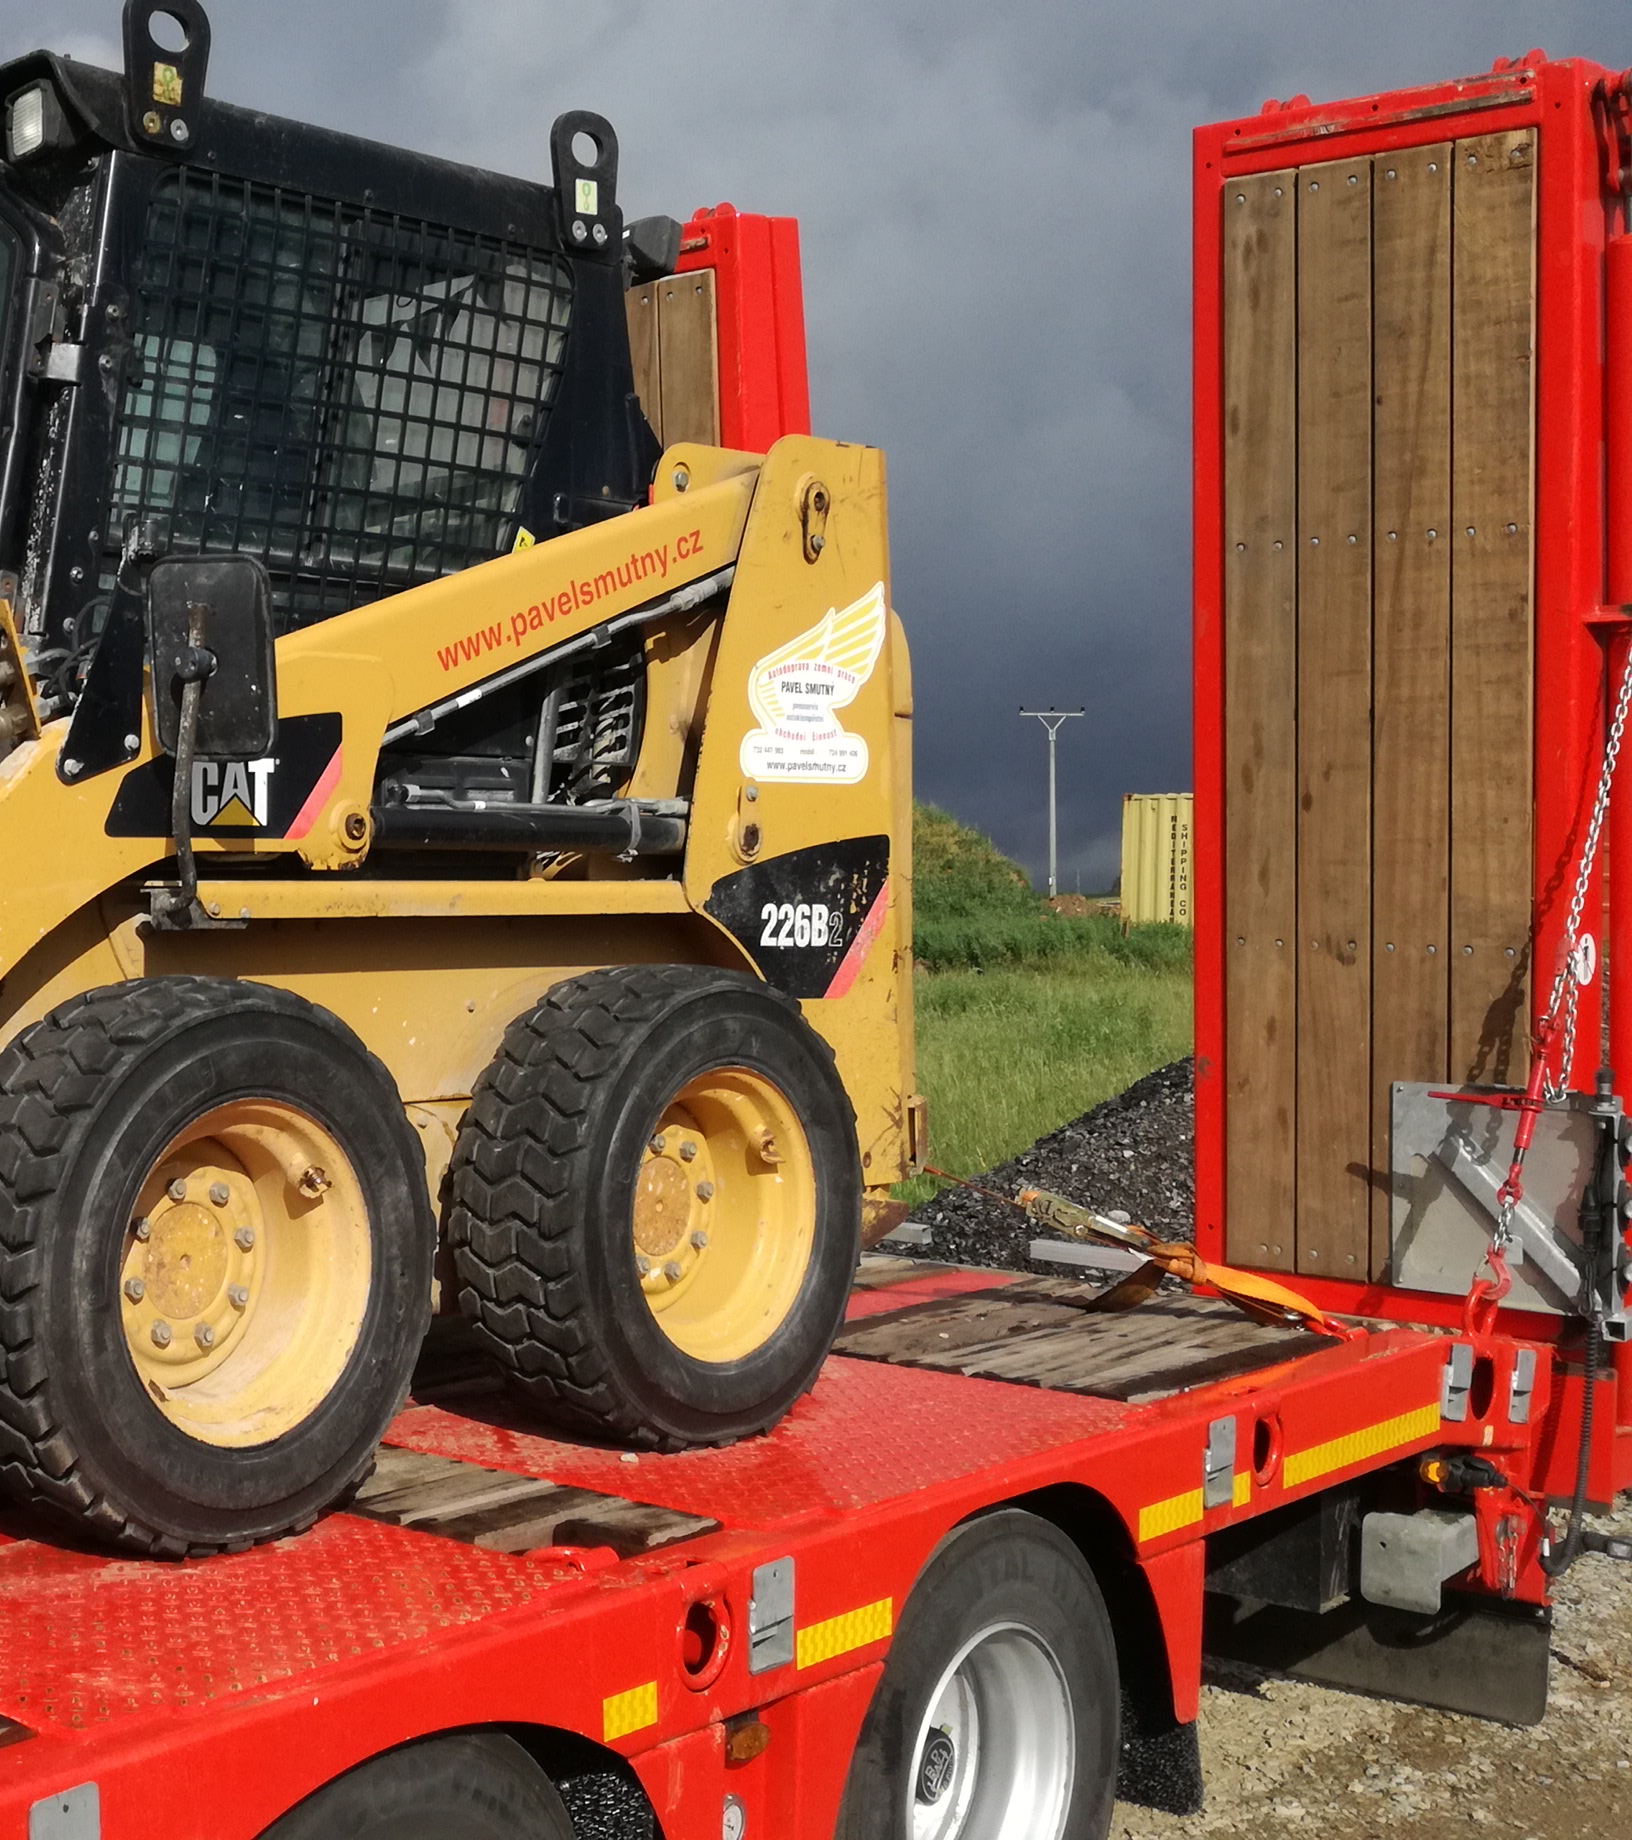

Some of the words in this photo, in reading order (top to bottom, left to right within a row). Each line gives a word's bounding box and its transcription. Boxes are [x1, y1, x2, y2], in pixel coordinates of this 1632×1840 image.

[436, 528, 705, 672] www.pavelsmutny.cz
[768, 662, 810, 680] Autodoprava
[781, 681, 803, 694] PAVEL
[805, 682, 835, 696] SMUTNÝ
[766, 761, 846, 774] www.pavelsmutny.cz
[190, 758, 276, 827] CAT
[1179, 824, 1188, 891] SHIPPING
[1178, 900, 1187, 916] CO
